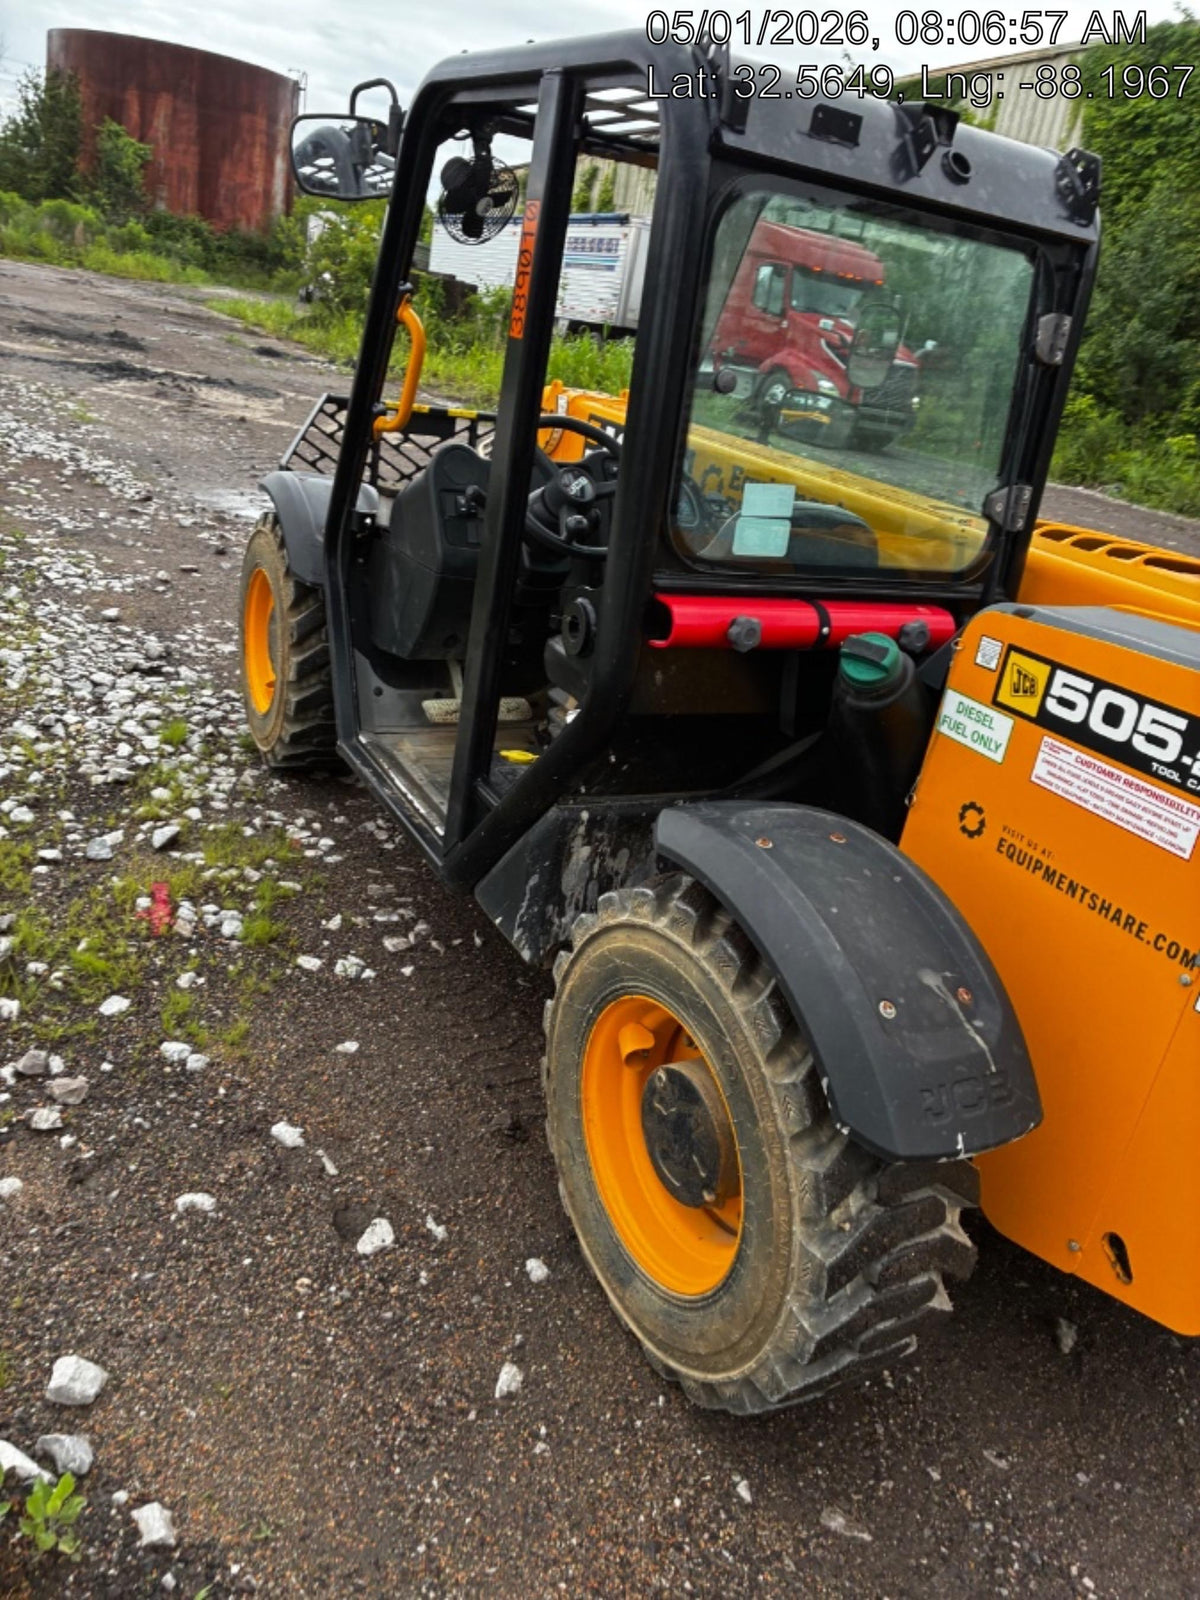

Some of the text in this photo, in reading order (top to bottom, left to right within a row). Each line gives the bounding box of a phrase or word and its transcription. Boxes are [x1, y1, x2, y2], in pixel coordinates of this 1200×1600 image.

[511, 202, 538, 337] 389010
[1012, 668, 1038, 696] JCB
[956, 701, 995, 731] DIESEL
[941, 714, 1003, 754] FUEL ONLY
[1075, 755, 1122, 785] CUSTOMER
[1151, 762, 1182, 783] TOOL
[996, 836, 1197, 972] EQUIPMENTSHARE.COM
[919, 1070, 1016, 1125] JCB
